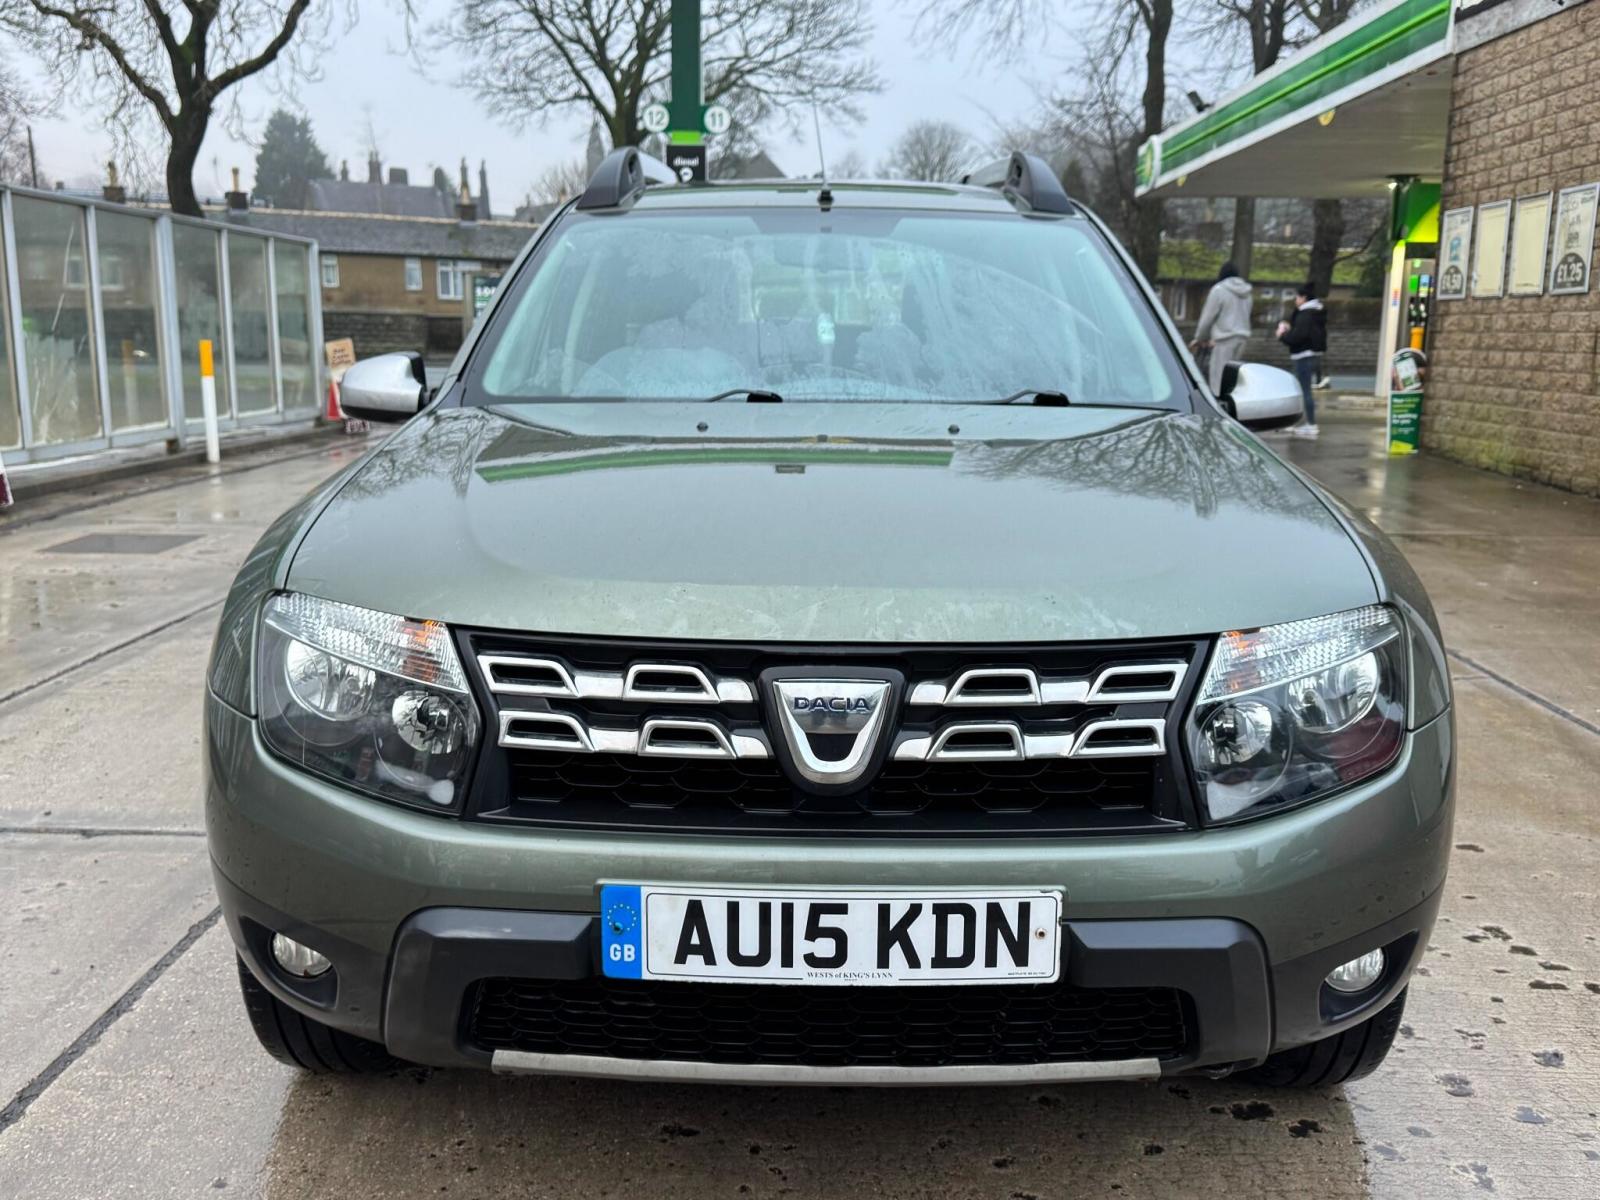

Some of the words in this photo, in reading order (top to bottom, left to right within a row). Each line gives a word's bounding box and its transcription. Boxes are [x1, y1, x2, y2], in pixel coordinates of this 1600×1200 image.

[647, 111, 666, 127] 12
[710, 112, 725, 129] 11
[673, 156, 699, 166] diesel
[1557, 263, 1583, 282] £1.25
[794, 697, 870, 711] DACIA
[674, 899, 849, 969] AU15
[877, 901, 1031, 969] KDN
[609, 943, 636, 962] GB
